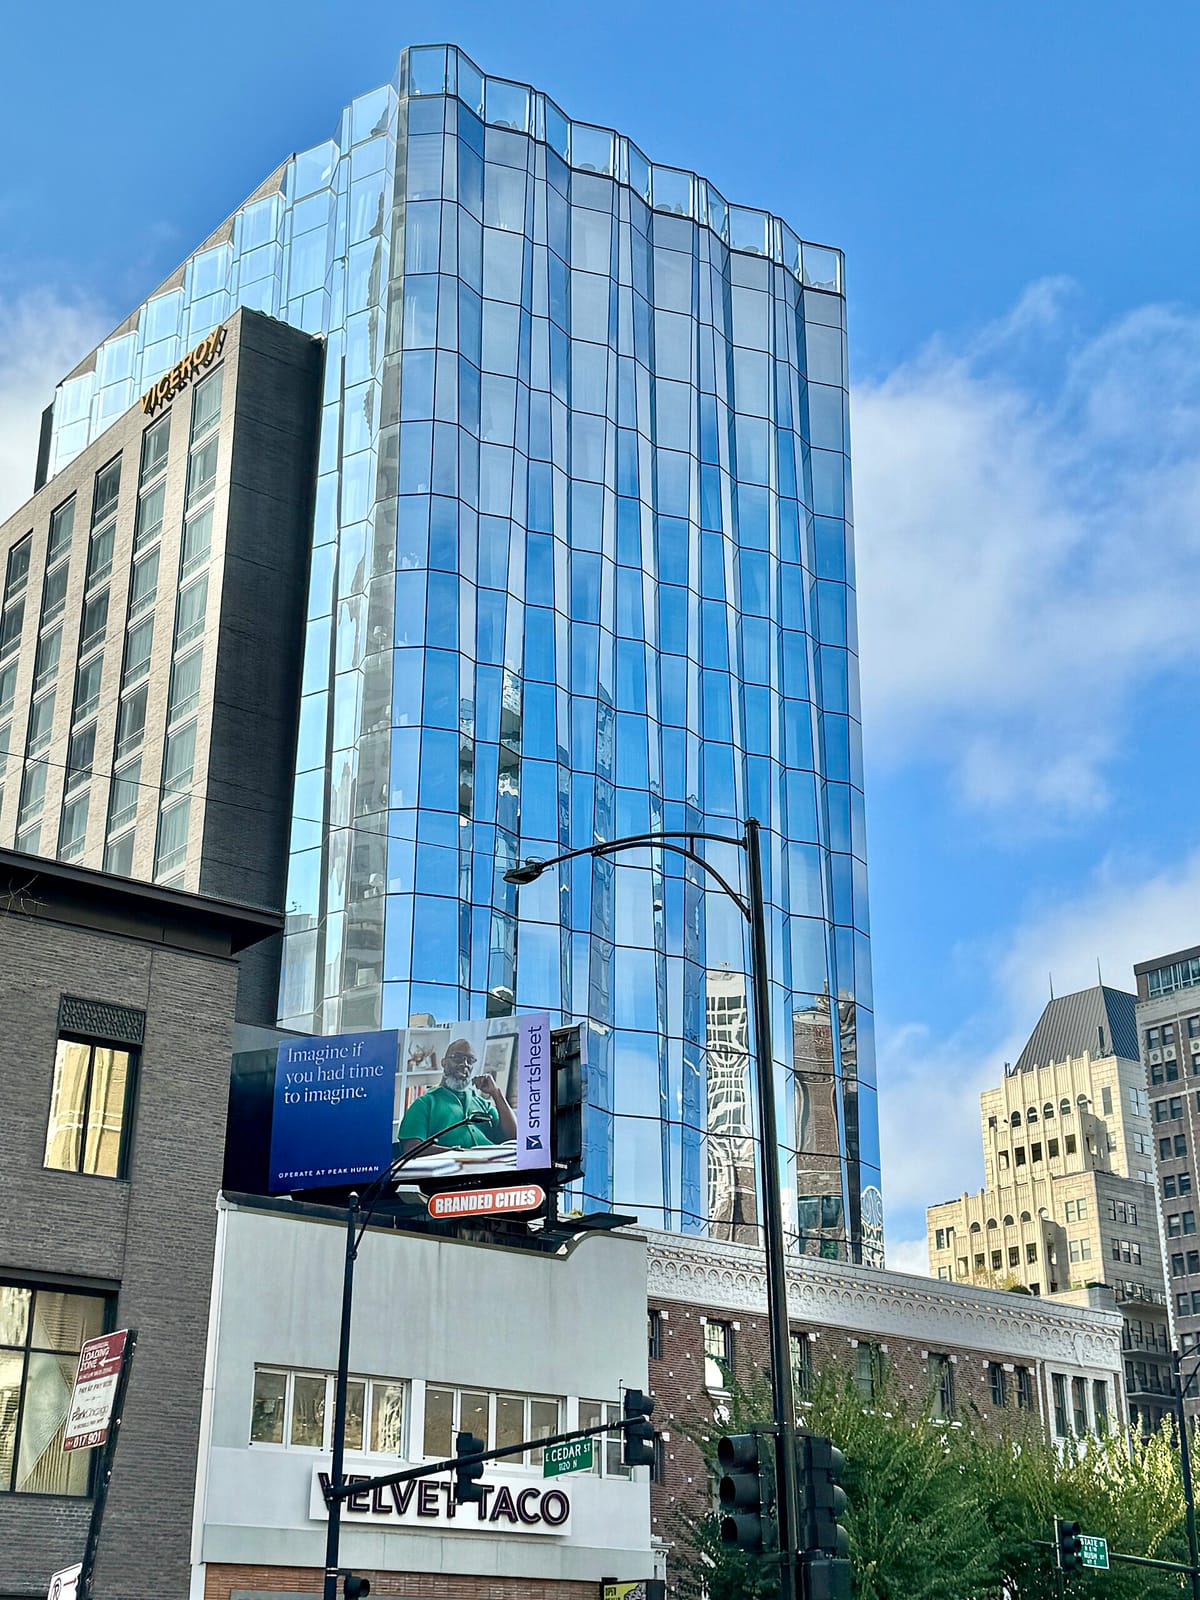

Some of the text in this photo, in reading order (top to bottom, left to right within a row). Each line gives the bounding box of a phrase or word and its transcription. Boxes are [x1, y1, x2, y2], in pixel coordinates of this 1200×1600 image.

[141, 325, 224, 414] VICEROY
[287, 1041, 365, 1065] Imagine if
[284, 1063, 384, 1090] you had time
[523, 1025, 543, 1129] smartsheet
[284, 1084, 368, 1106] to imagine.
[278, 1170, 313, 1179] OPERATE
[327, 1167, 348, 1175] PEAK
[350, 1165, 379, 1174] HUMAN
[435, 1189, 537, 1214] BRANDED CITIES
[83, 1347, 110, 1361] LOADING
[545, 1443, 591, 1462] E CEDAR ST
[572, 1459, 578, 1469] N
[474, 1483, 570, 1526] TACO
